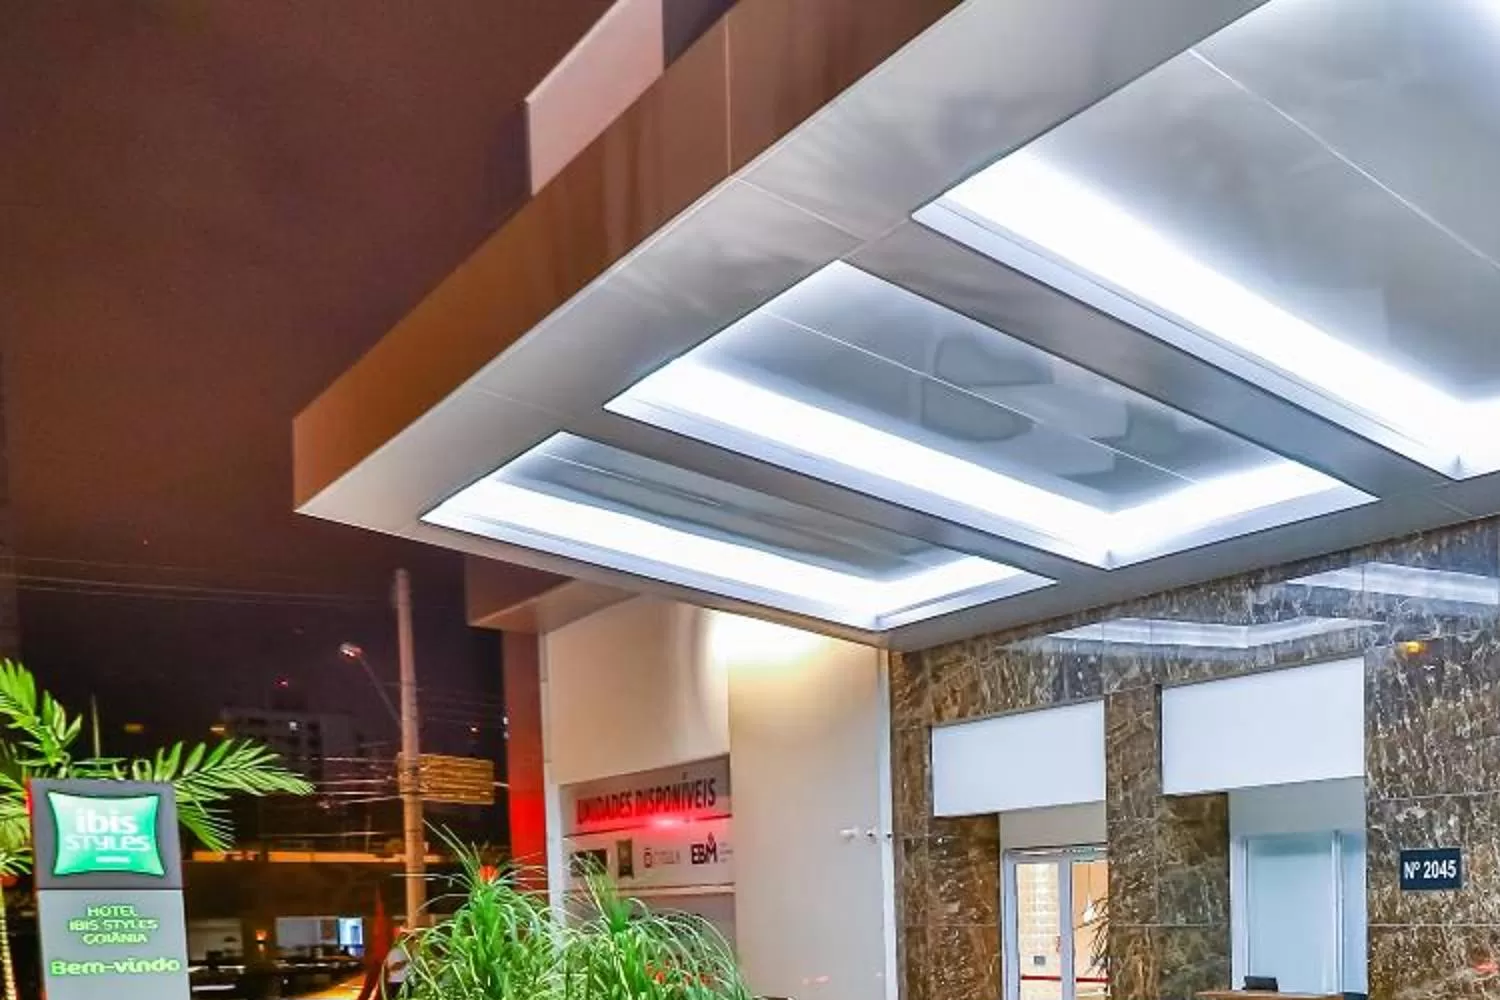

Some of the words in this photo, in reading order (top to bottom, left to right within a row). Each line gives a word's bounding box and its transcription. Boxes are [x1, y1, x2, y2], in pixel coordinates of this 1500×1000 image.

[75, 808, 138, 833] ibis
[1423, 860, 1457, 879] 2045
[87, 905, 138, 917] HOTEL
[69, 919, 98, 931] IBIS
[102, 918, 158, 930] STYLES
[50, 956, 181, 977] Bem-vindo
